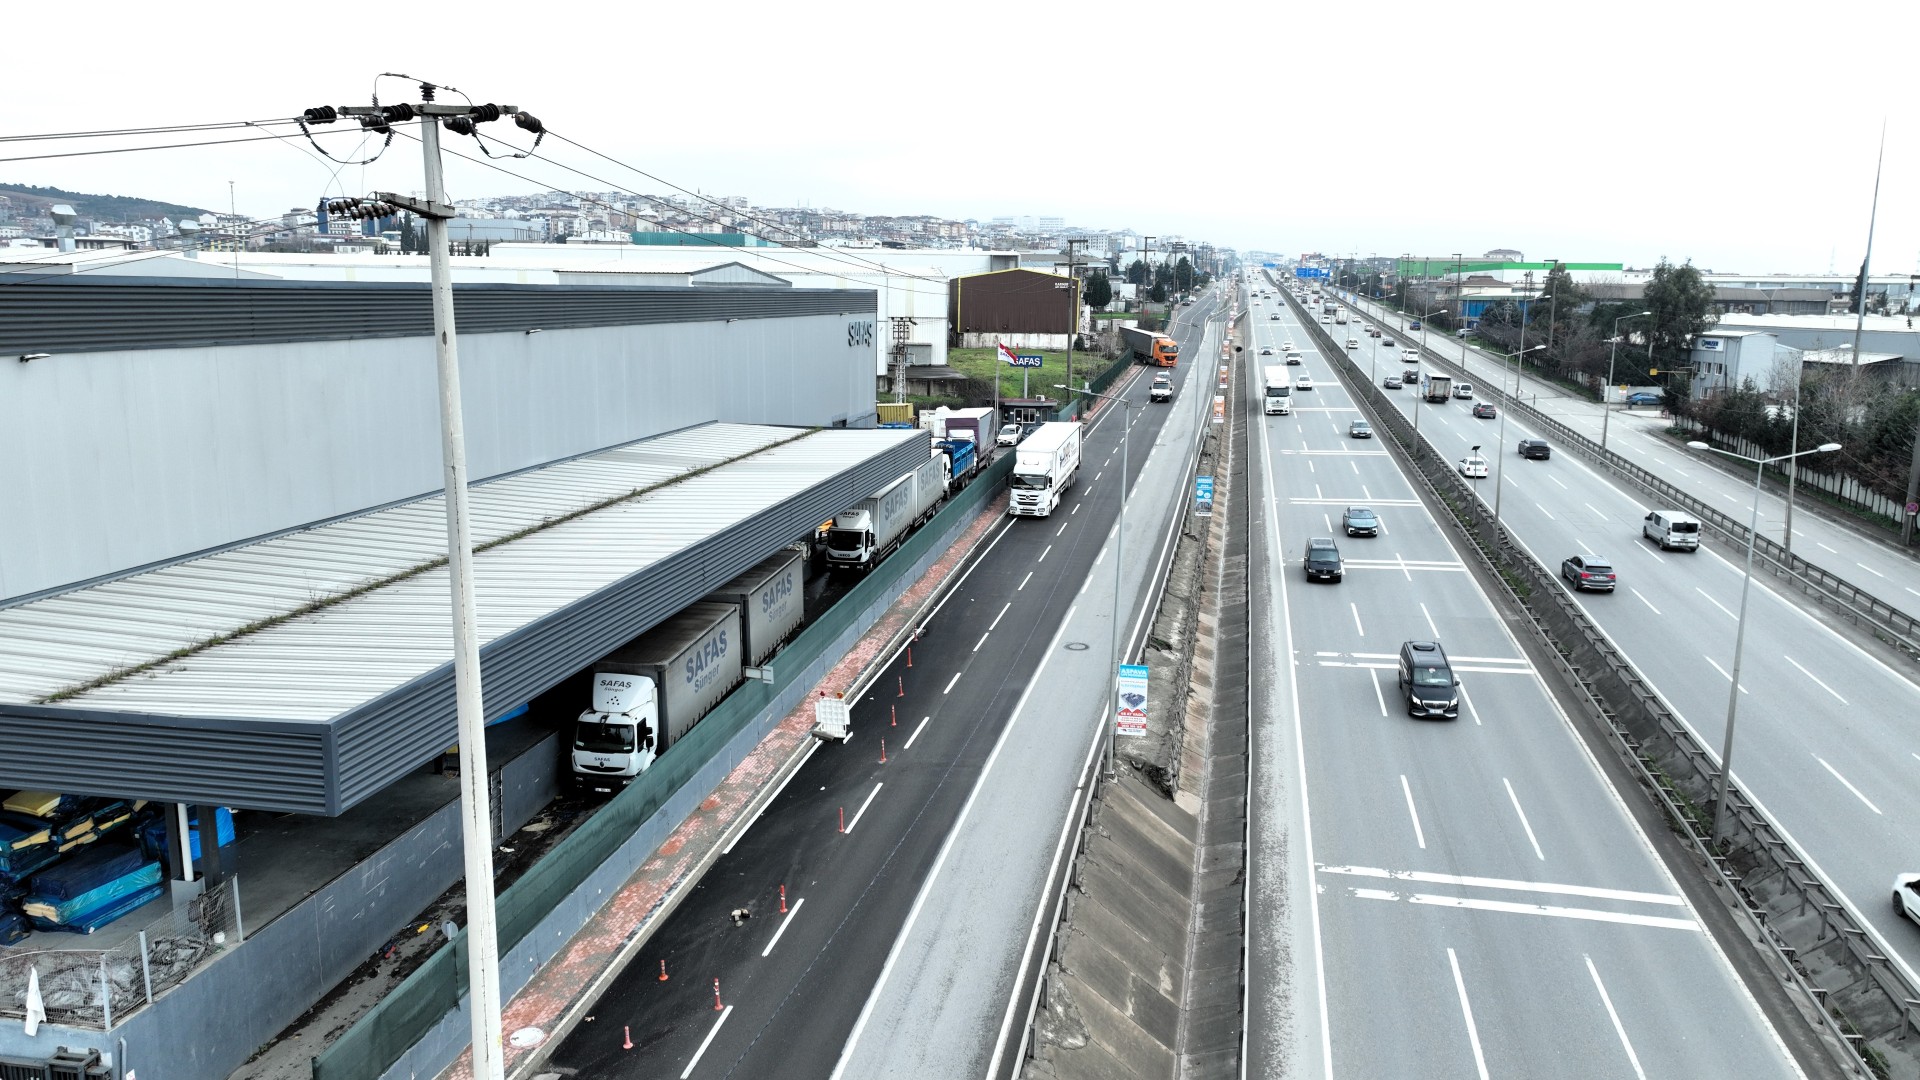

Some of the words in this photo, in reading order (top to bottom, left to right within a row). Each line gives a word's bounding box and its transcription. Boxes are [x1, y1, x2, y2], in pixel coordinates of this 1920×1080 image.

[762, 572, 792, 613] SAFAŞ
[686, 630, 727, 683] SAFAŞ
[694, 663, 719, 693] Sünger
